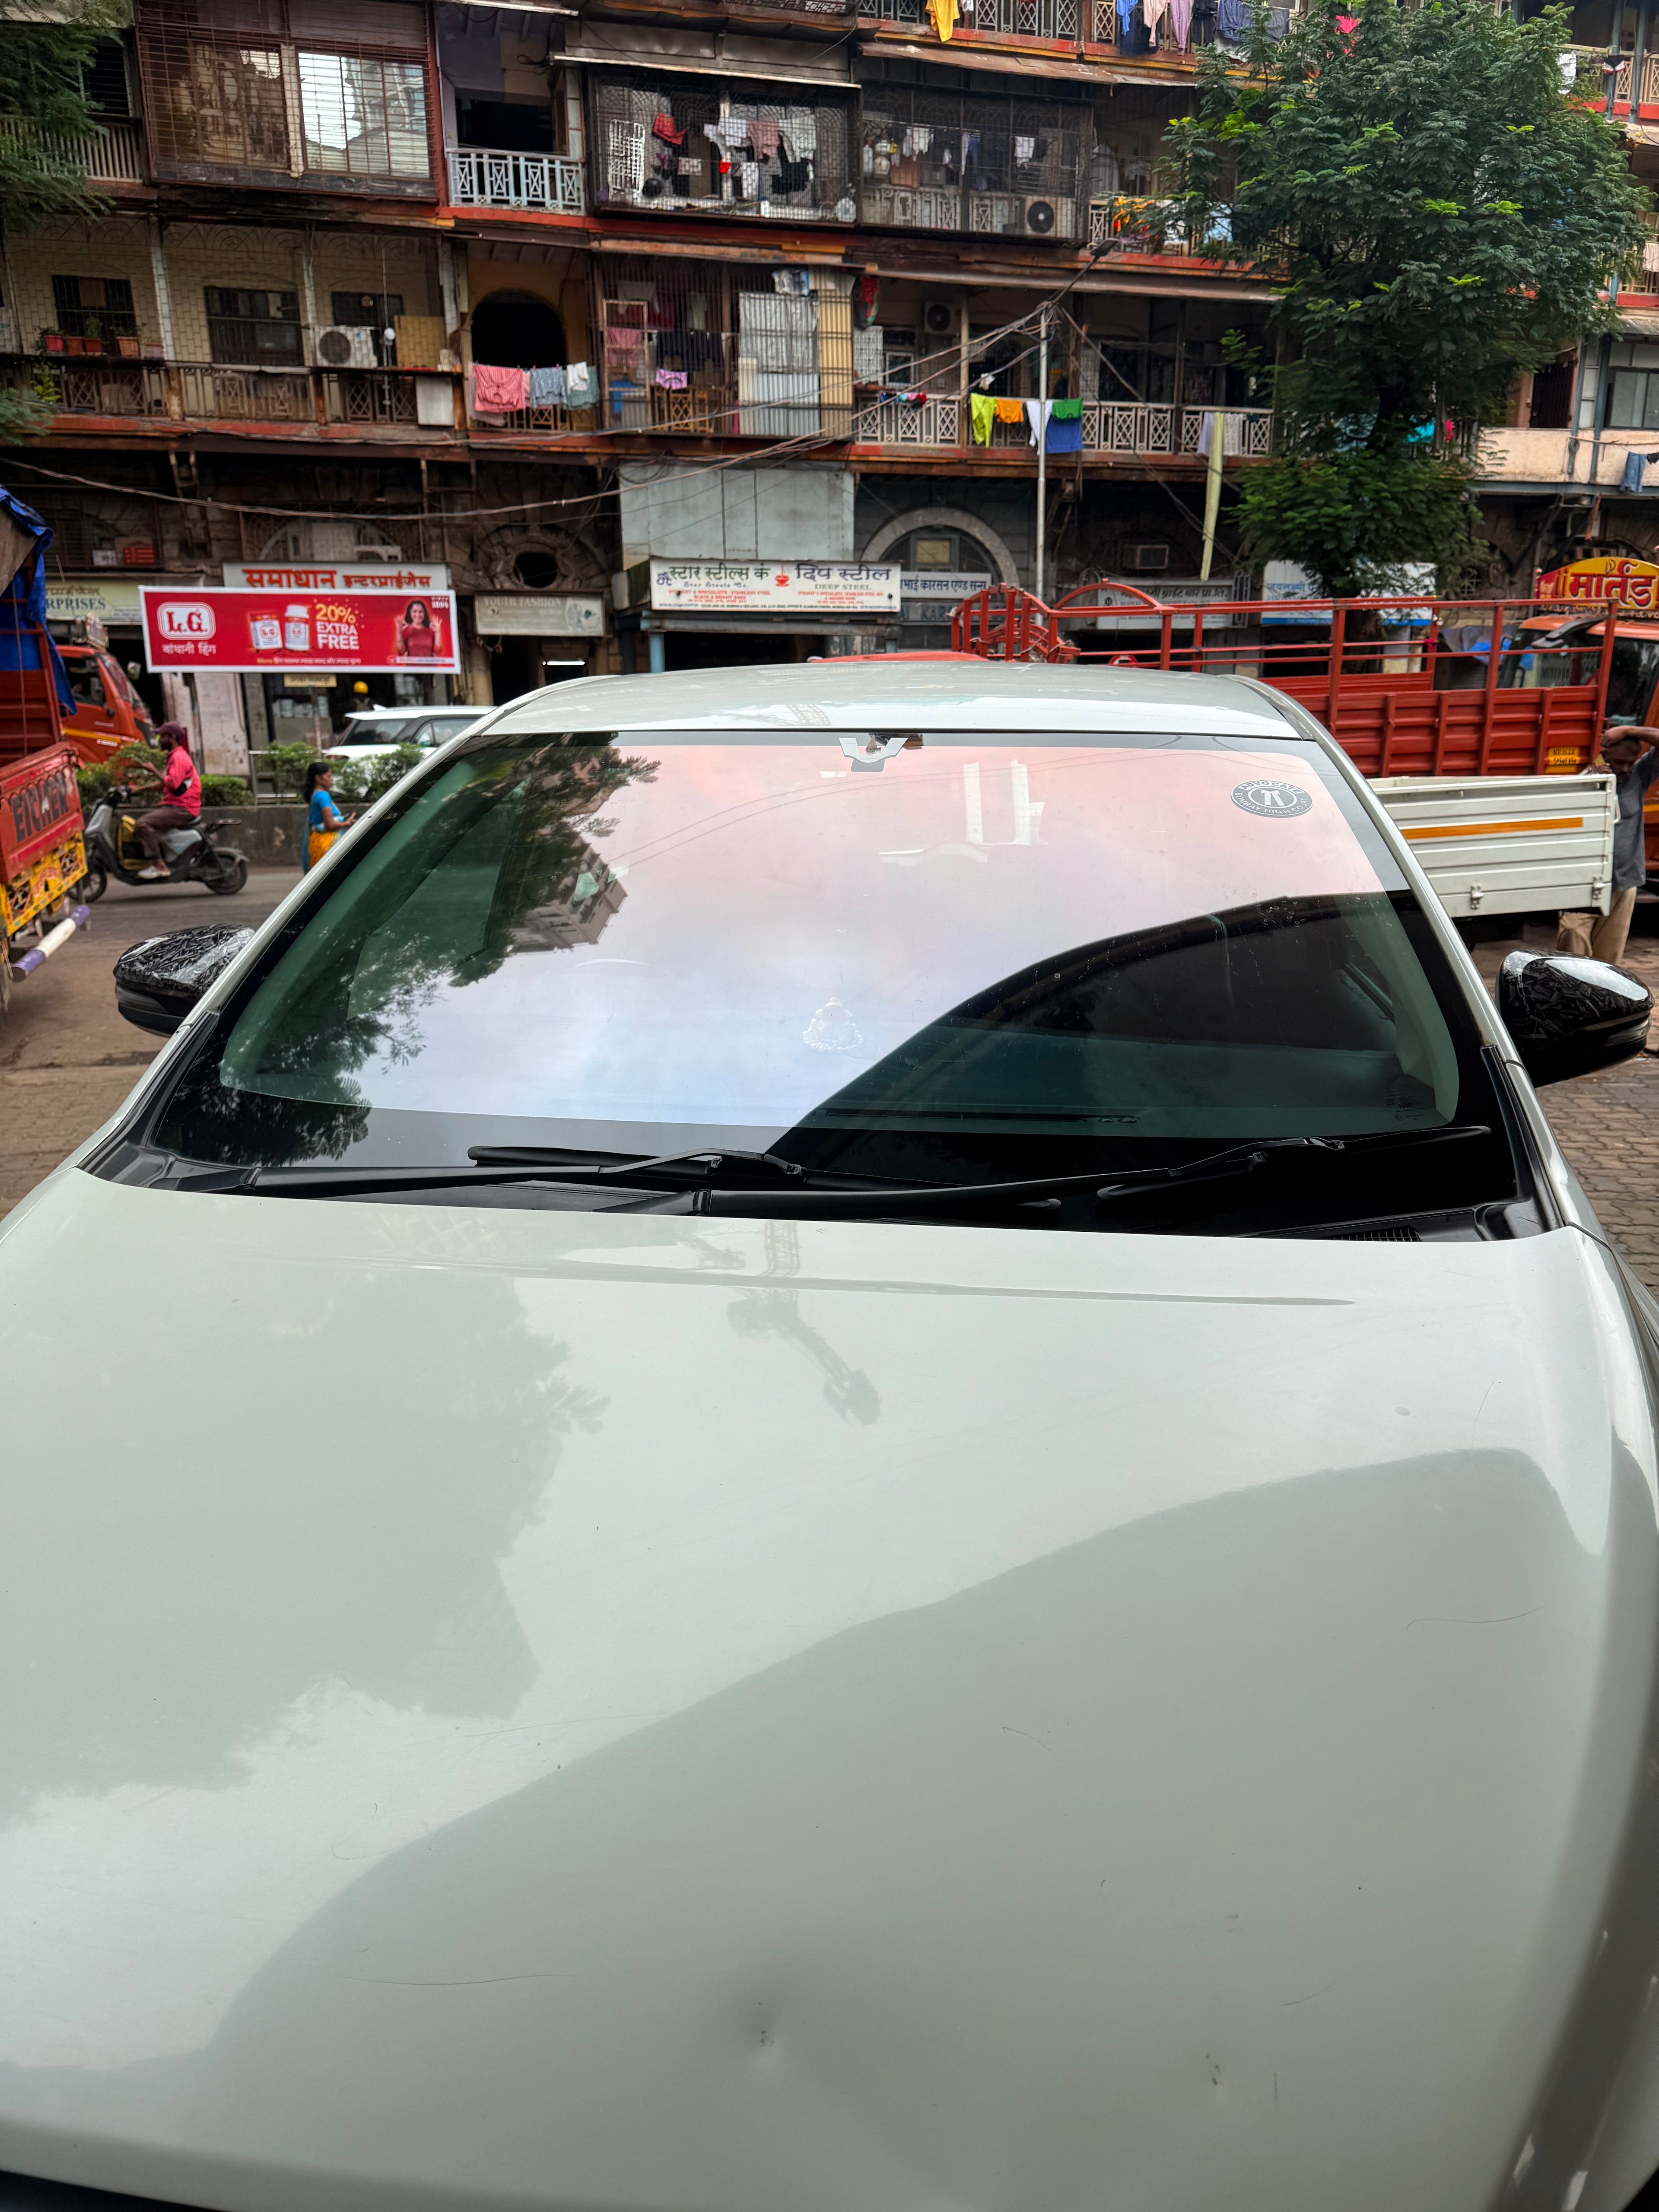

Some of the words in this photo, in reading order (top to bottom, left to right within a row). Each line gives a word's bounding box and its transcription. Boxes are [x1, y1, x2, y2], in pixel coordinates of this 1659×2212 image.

[242, 569, 337, 588] समाधान
[668, 566, 701, 580] स्टार
[705, 562, 750, 580] स्टील्स
[837, 564, 892, 581] स्टील
[46, 597, 106, 610] RPRISES
[483, 597, 517, 607] YOUTH
[519, 597, 562, 607] FASHION
[166, 611, 208, 632] L.G.
[315, 603, 356, 624] 20%
[316, 621, 358, 635] EXTRA
[318, 634, 359, 650] FREE
[1240, 781, 1302, 794] ADVOCATE
[12, 772, 69, 843] EICHER
[1235, 792, 1262, 810] BOMBAY
[1292, 798, 1309, 812] COURT
